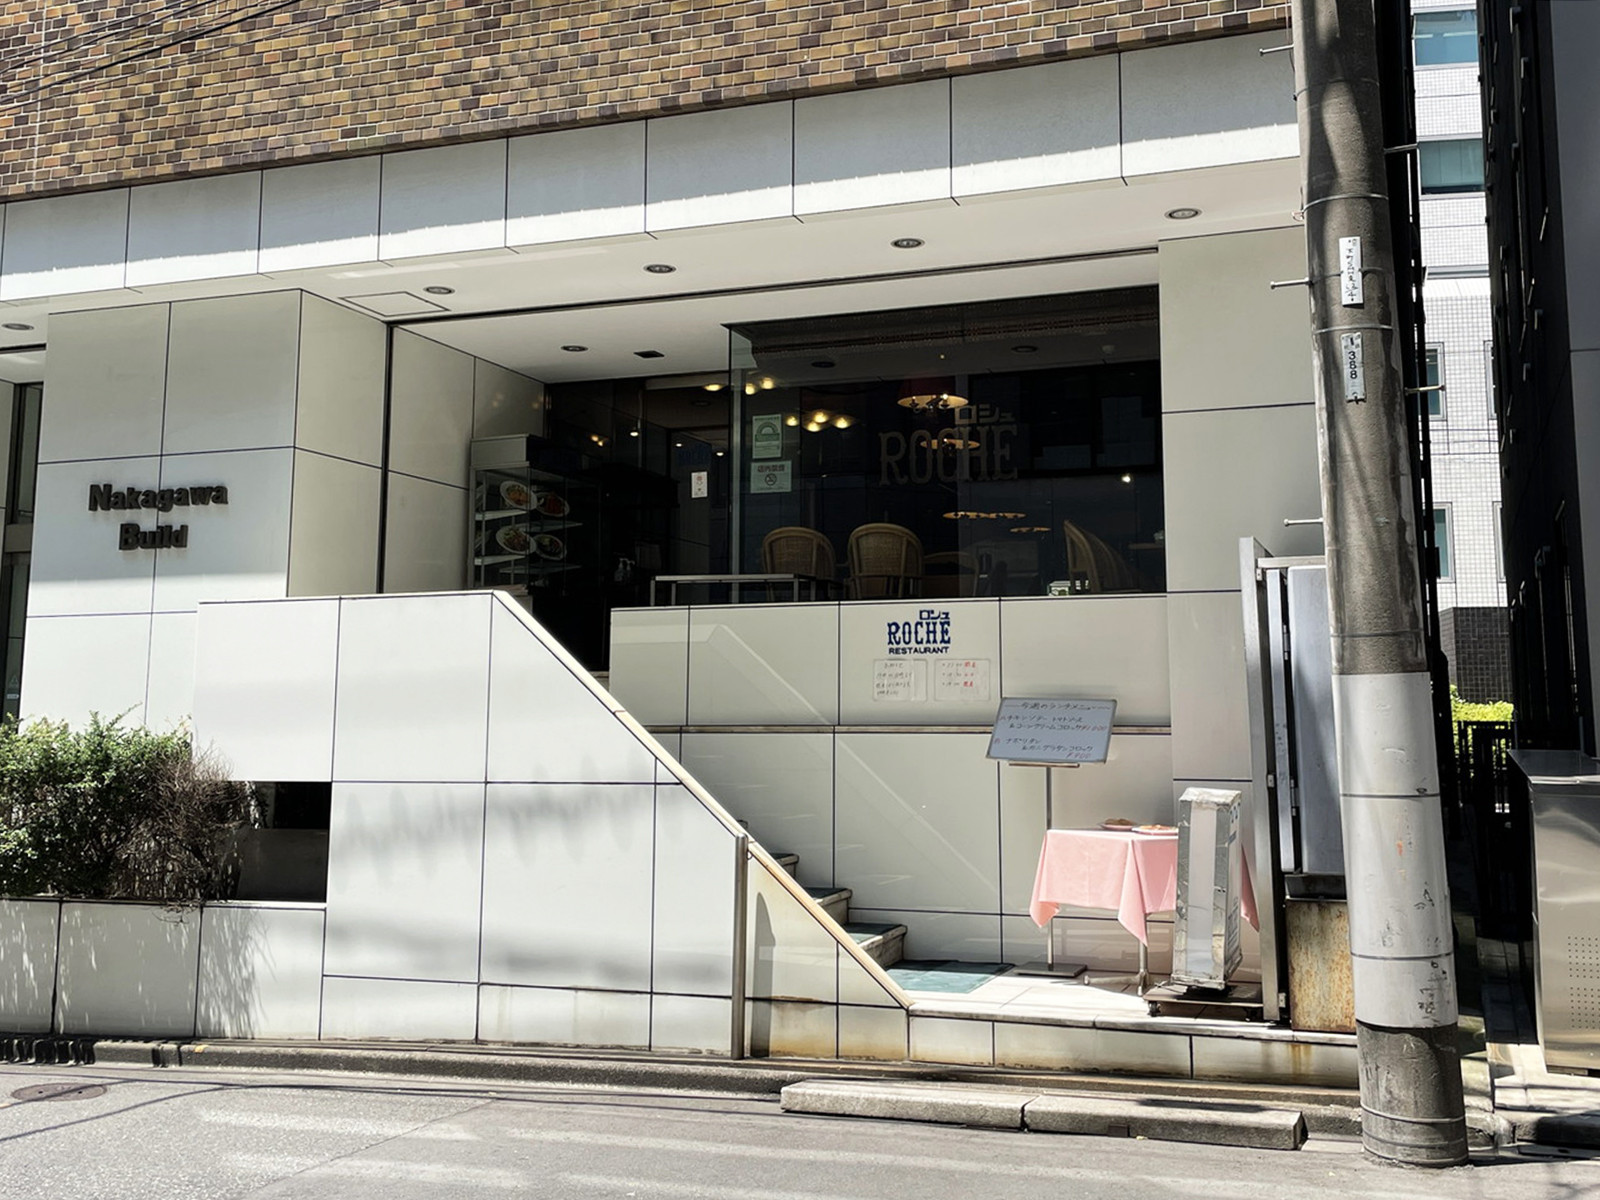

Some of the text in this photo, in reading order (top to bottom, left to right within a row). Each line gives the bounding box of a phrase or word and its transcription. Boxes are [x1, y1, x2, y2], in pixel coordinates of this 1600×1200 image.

[1348, 350, 1358, 380] 388
[878, 424, 1018, 486] ROCHE
[88, 484, 229, 512] Nakagawa
[118, 523, 189, 551] Build
[887, 620, 951, 646] ROCHE
[888, 646, 950, 655] RESTAURANT
